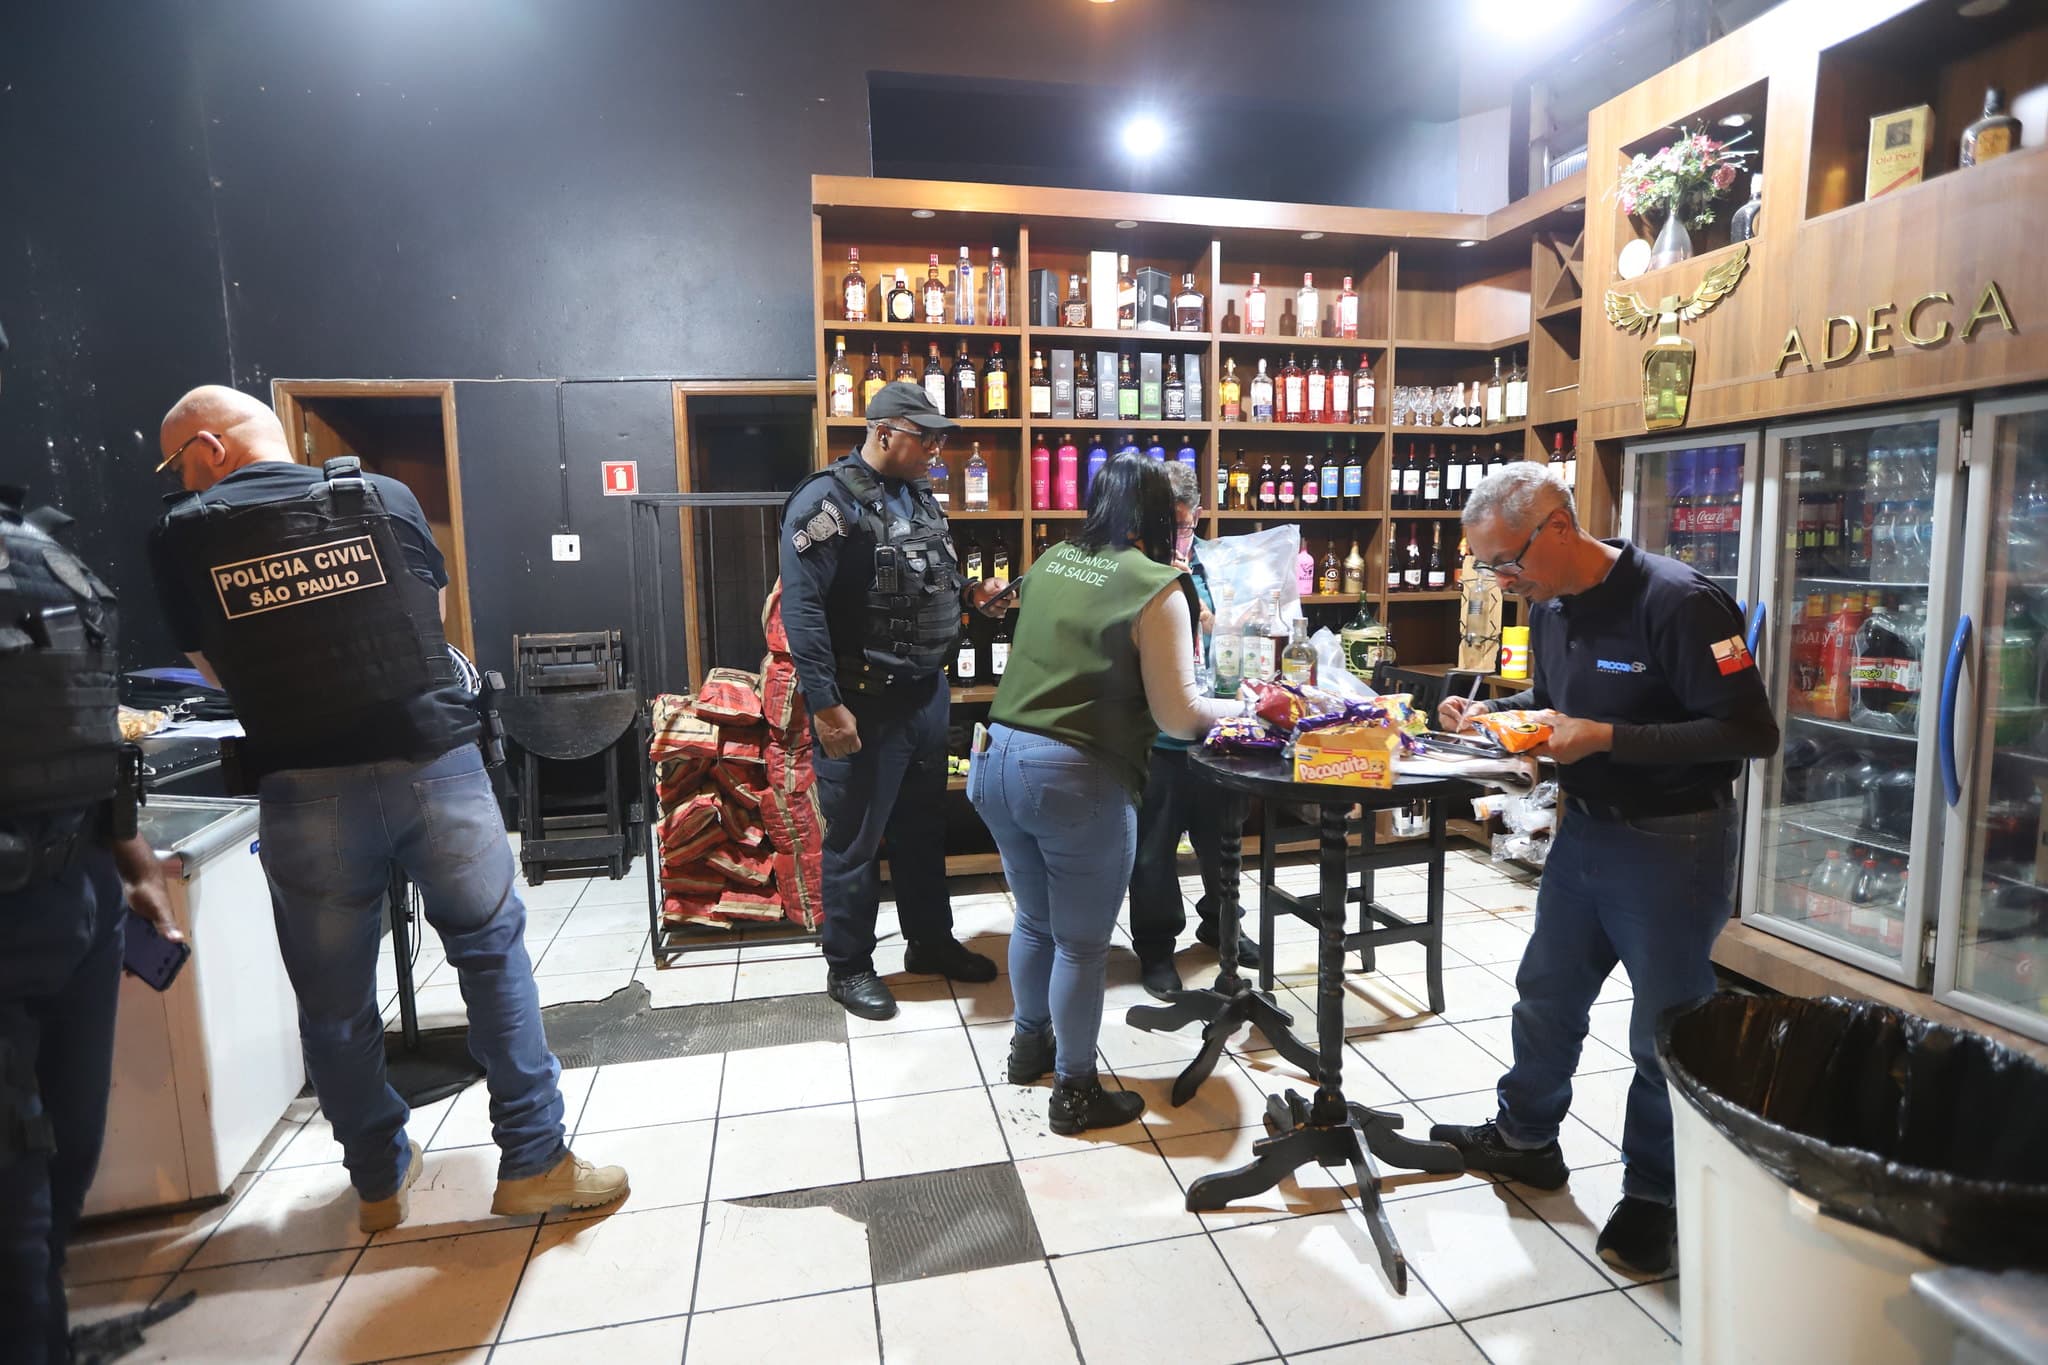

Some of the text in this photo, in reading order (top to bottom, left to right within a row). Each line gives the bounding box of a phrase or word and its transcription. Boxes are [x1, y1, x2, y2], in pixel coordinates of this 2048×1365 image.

[1774, 280, 2014, 374] ADEGA
[218, 544, 372, 592] POLÍCIA CIVIL
[250, 570, 360, 608] SÃO PAULO
[1046, 561, 1109, 588] EM SAÚDE
